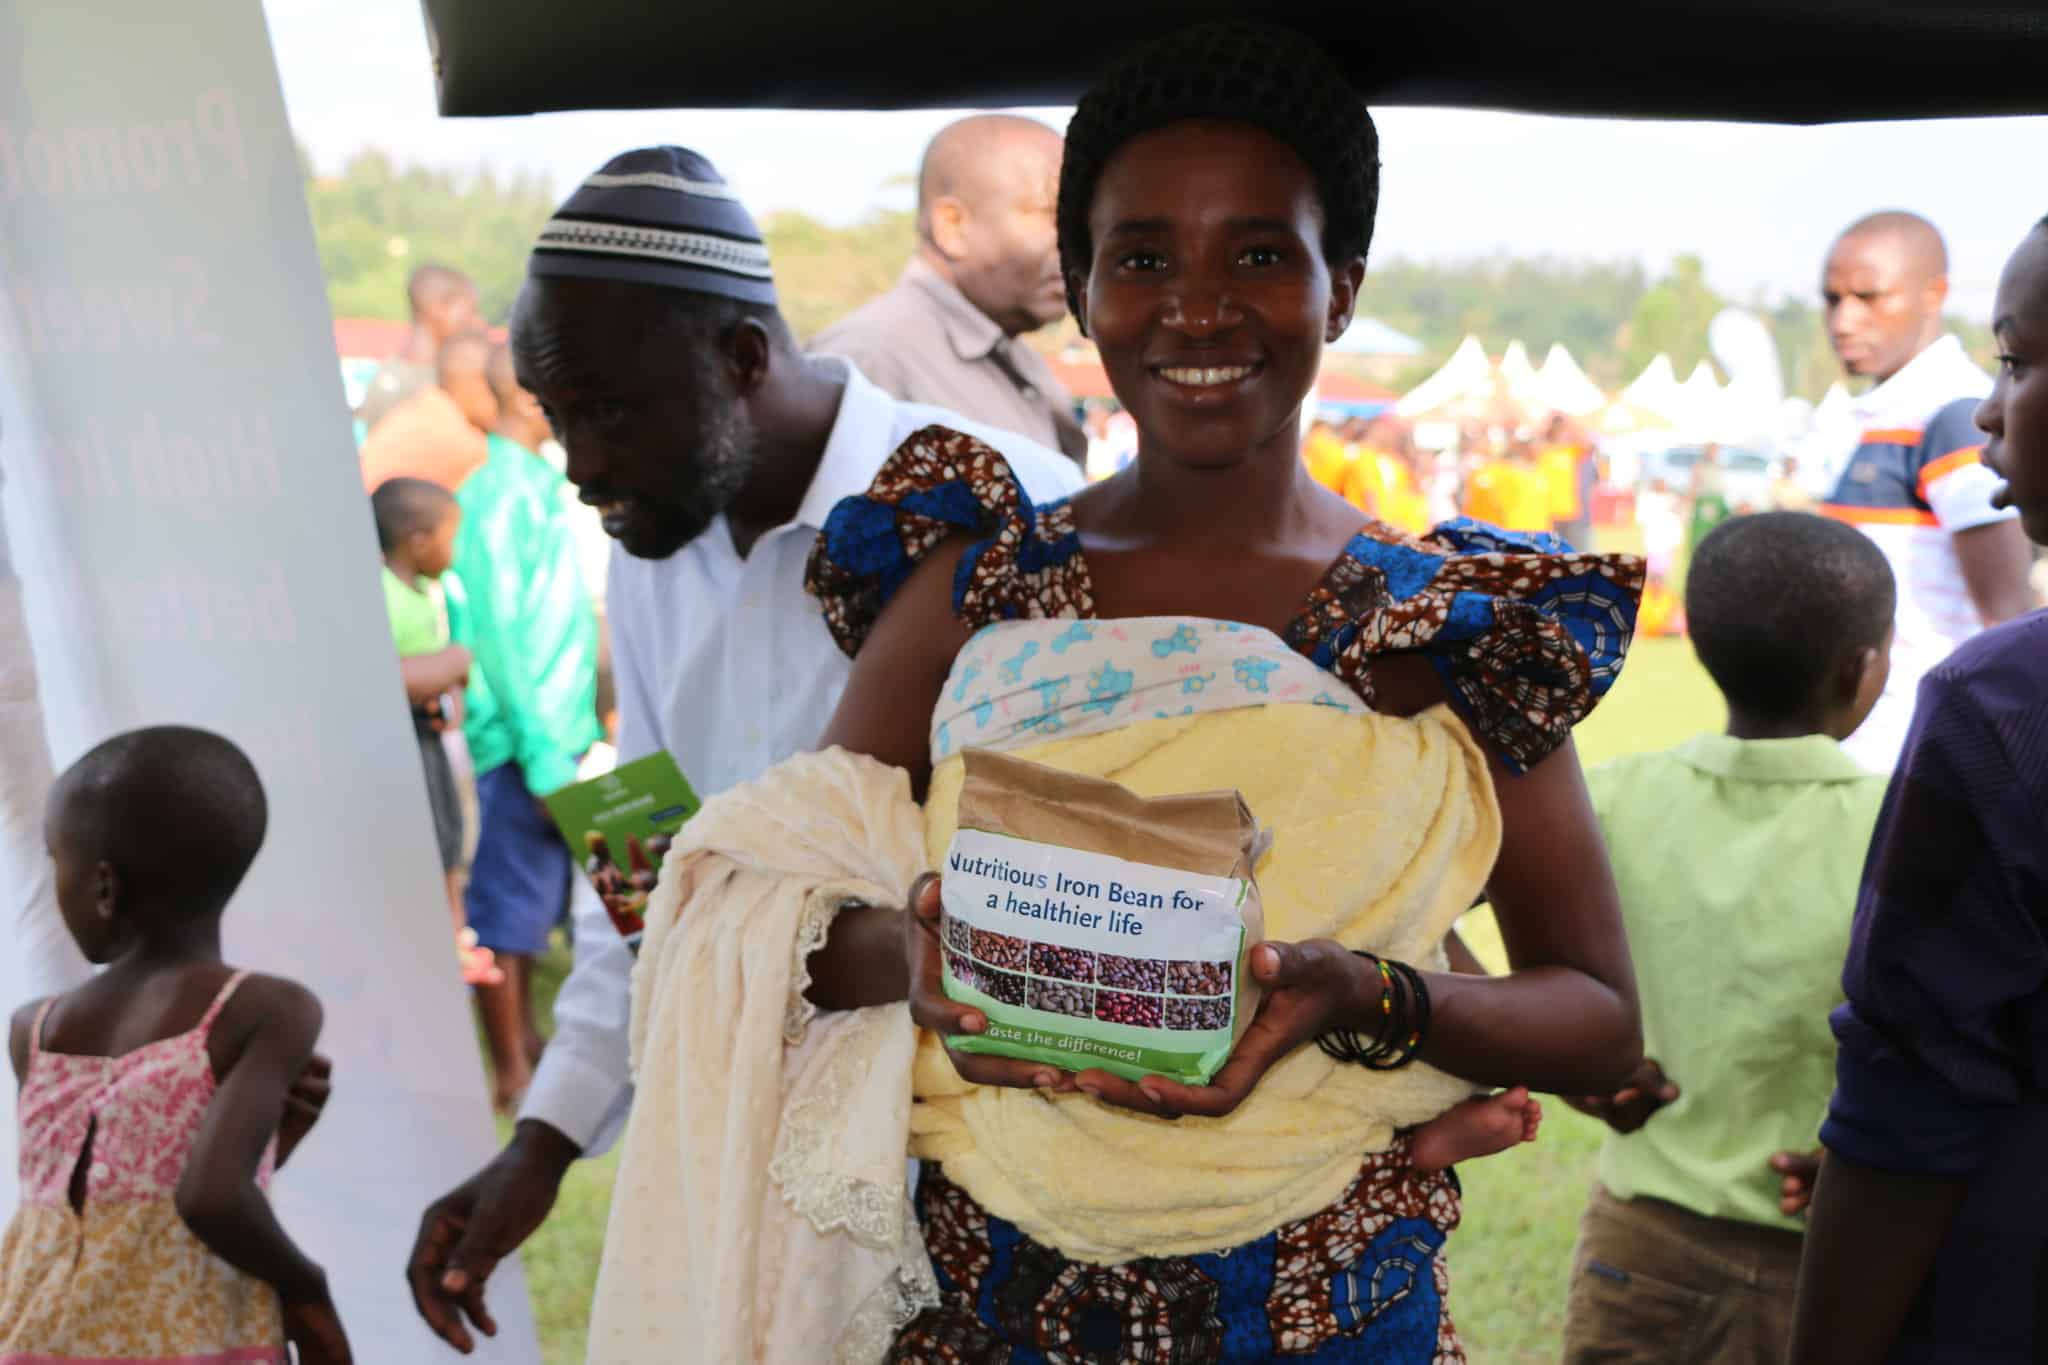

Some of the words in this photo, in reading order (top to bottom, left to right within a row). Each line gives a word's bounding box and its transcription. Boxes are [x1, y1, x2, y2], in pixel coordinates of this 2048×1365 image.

[950, 852, 1049, 889] Nutritious
[1055, 872, 1100, 899] Iron
[1108, 881, 1164, 909] Bean
[1172, 890, 1204, 911] for
[986, 893, 998, 909] a
[1005, 890, 1103, 929] healthier
[1108, 909, 1144, 936] life
[984, 1024, 1022, 1041] aste
[1026, 1030, 1053, 1046] the
[1057, 1036, 1142, 1064] difference!
